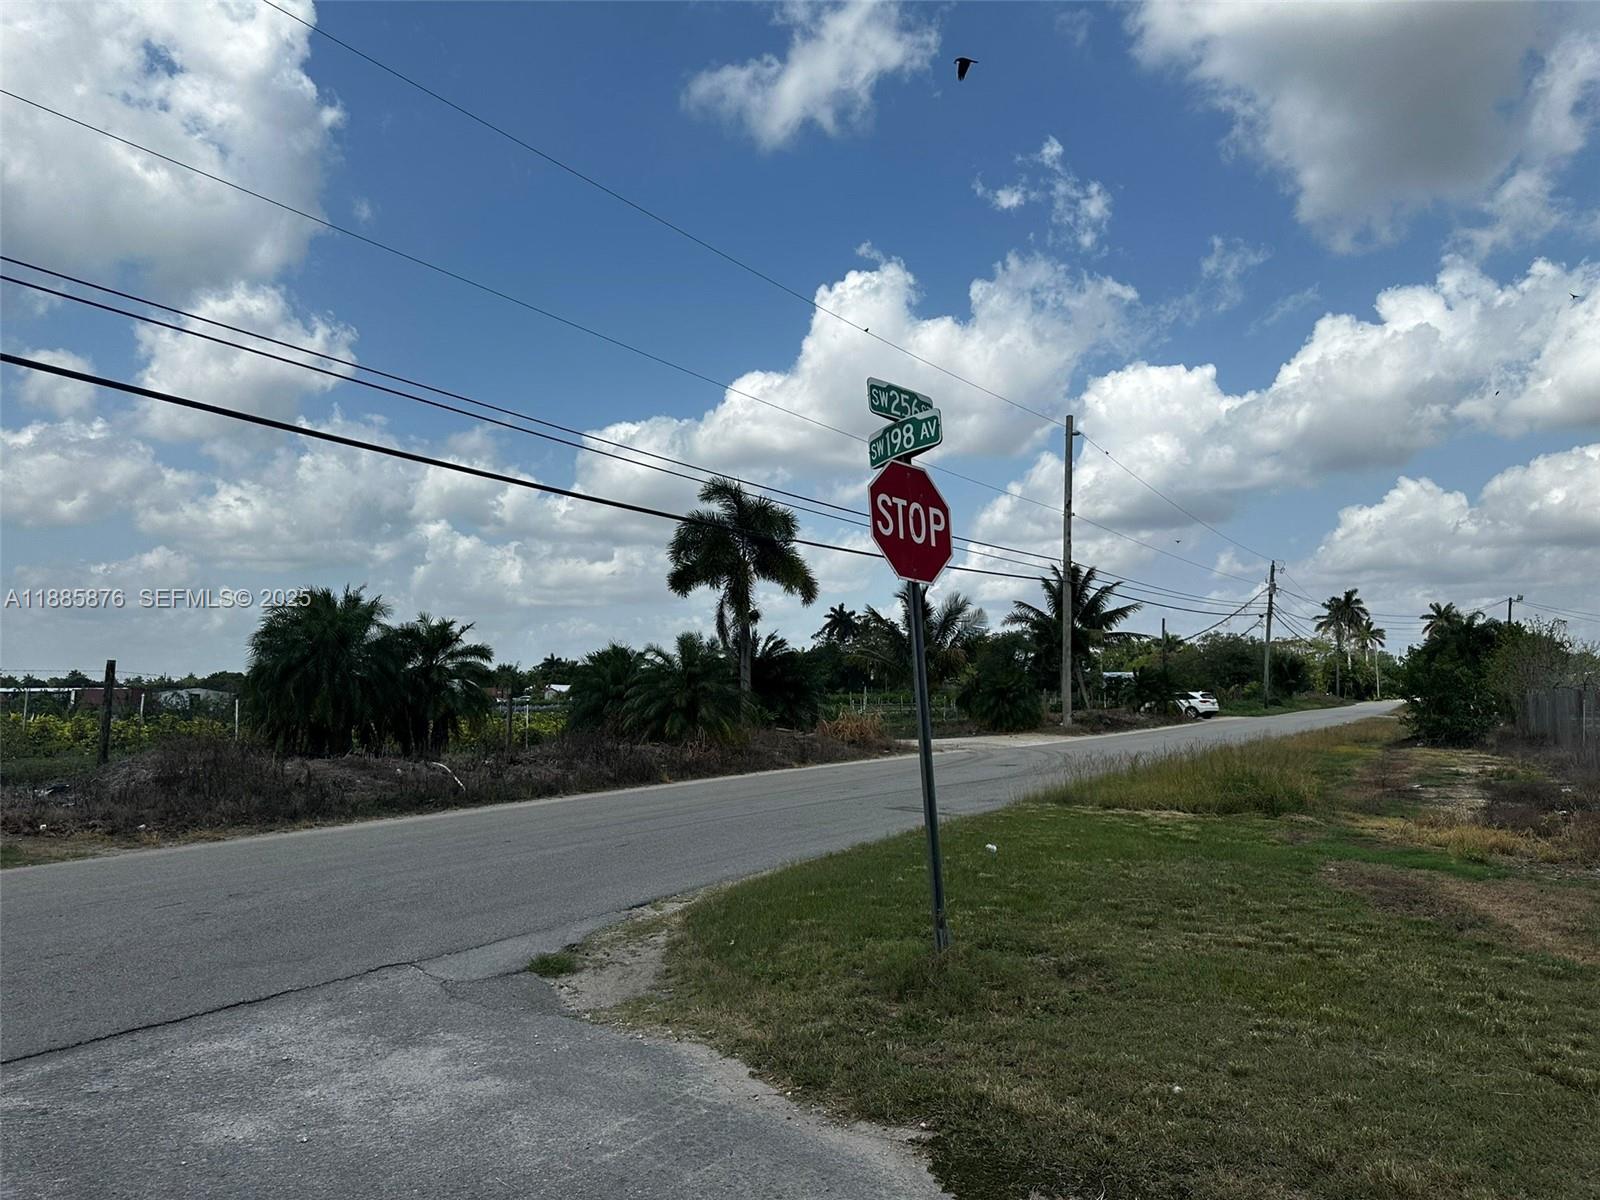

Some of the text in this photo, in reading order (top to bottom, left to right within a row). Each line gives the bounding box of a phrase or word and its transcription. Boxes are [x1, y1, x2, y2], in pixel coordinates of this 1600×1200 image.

[871, 388, 919, 418] SW 256
[871, 419, 937, 460] SW 198 AV
[876, 493, 945, 547] STOP
